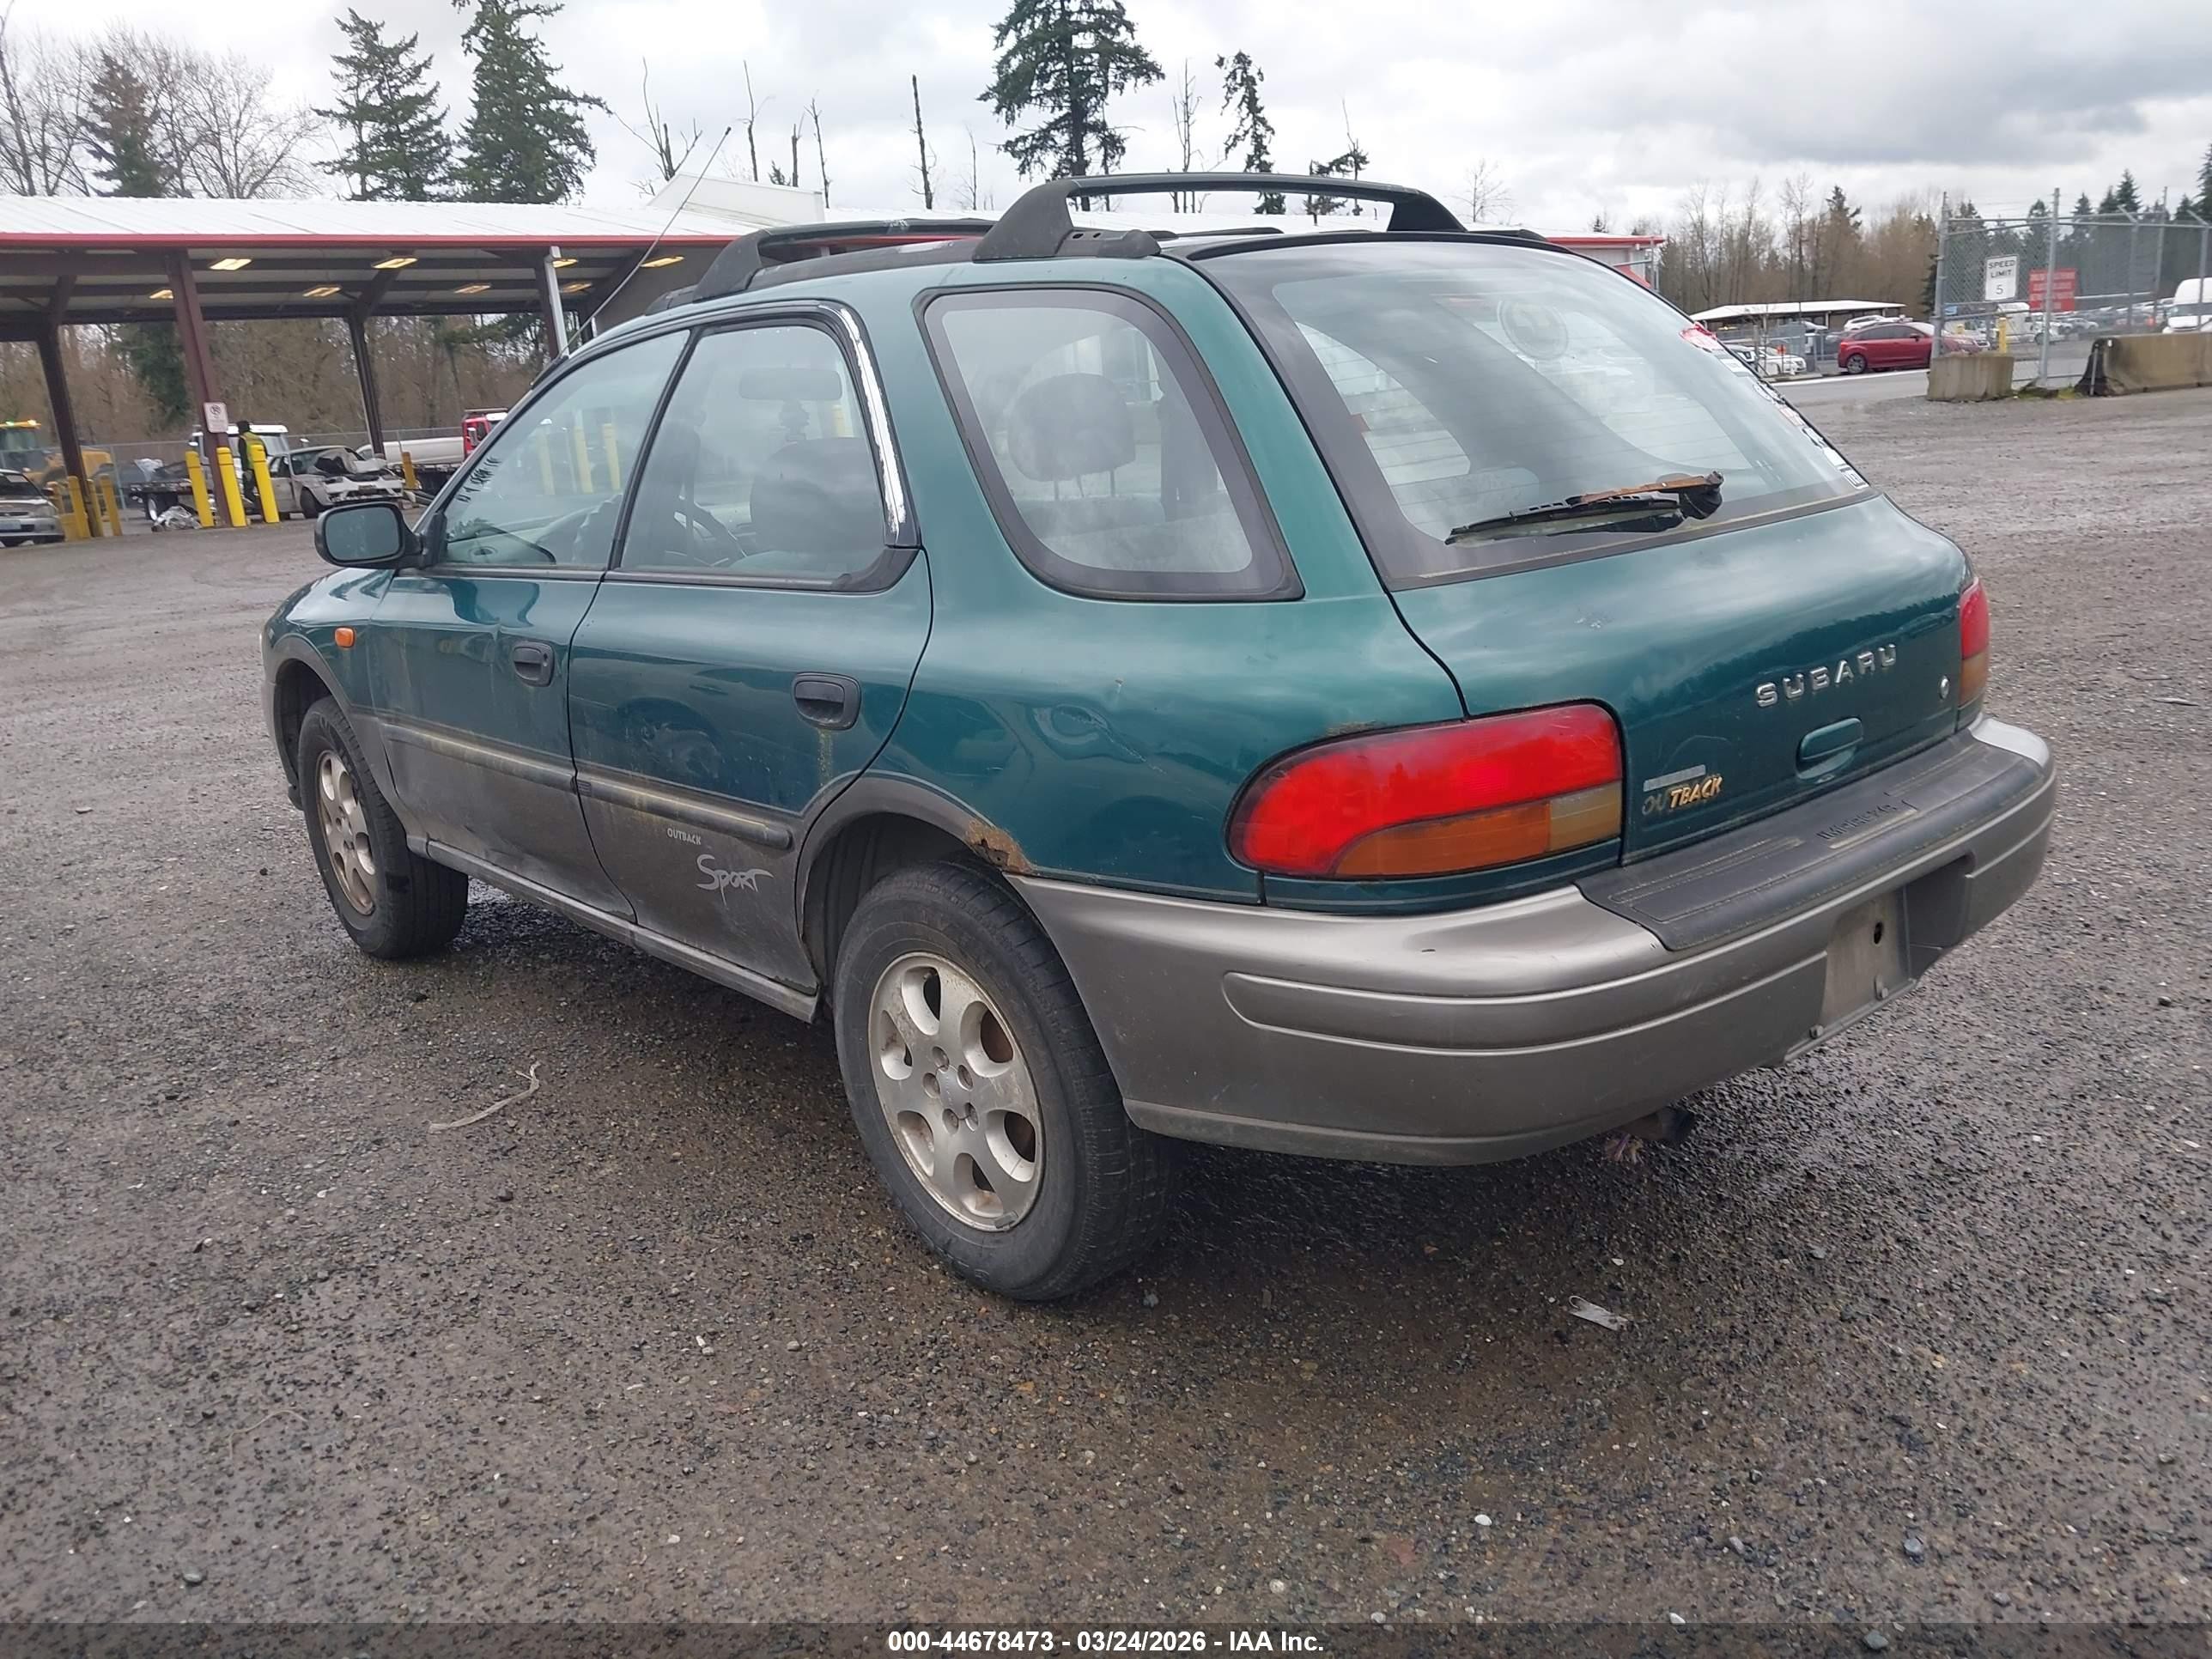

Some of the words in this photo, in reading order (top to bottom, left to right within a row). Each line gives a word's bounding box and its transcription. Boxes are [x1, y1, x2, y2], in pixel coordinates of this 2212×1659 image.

[1988, 260, 2015, 269] SPEED
[1990, 270, 2012, 278] LIMIT
[1996, 284, 2003, 295] 5
[1756, 644, 1897, 707] SUBARU
[667, 828, 702, 845] OUTBACK
